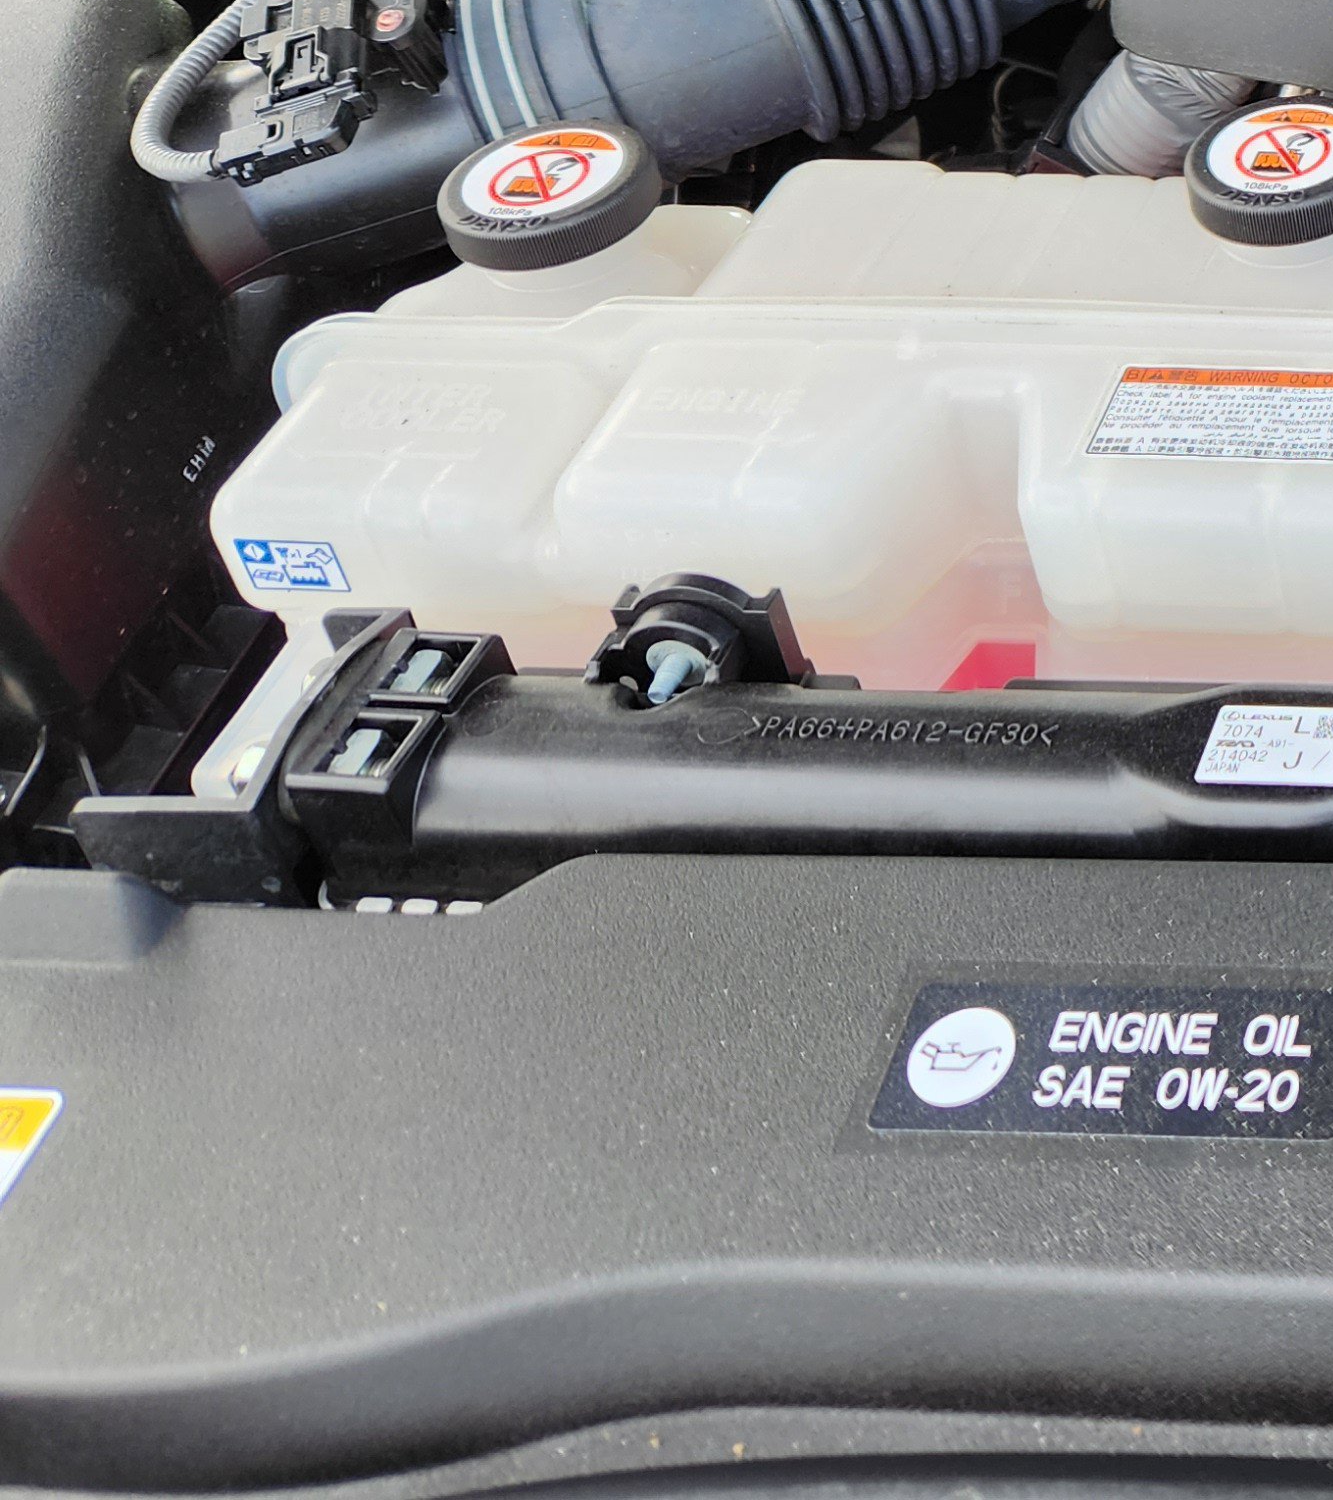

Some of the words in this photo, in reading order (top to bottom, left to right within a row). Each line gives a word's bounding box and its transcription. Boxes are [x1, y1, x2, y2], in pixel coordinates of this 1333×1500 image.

[1243, 181, 1289, 191] 108kPa
[1216, 188, 1306, 207] DENSO
[487, 206, 533, 217] 108kPa
[457, 213, 549, 233] DENSO
[1207, 372, 1280, 383] WARNING
[1267, 418, 1333, 426] remplacement
[1186, 423, 1254, 432] remplacement
[1284, 426, 1322, 434] lorsque
[1241, 713, 1293, 721] LEXUS
[1223, 724, 1264, 739] 7074
[1207, 750, 1269, 763] 214042
[1283, 751, 1303, 769] J
[1204, 762, 1241, 773] JAPAN
[1048, 1010, 1218, 1055] ENGINE
[1242, 1013, 1312, 1057] OIL
[1031, 1064, 1131, 1109] SAE
[1155, 1067, 1300, 1113] 0W-20
